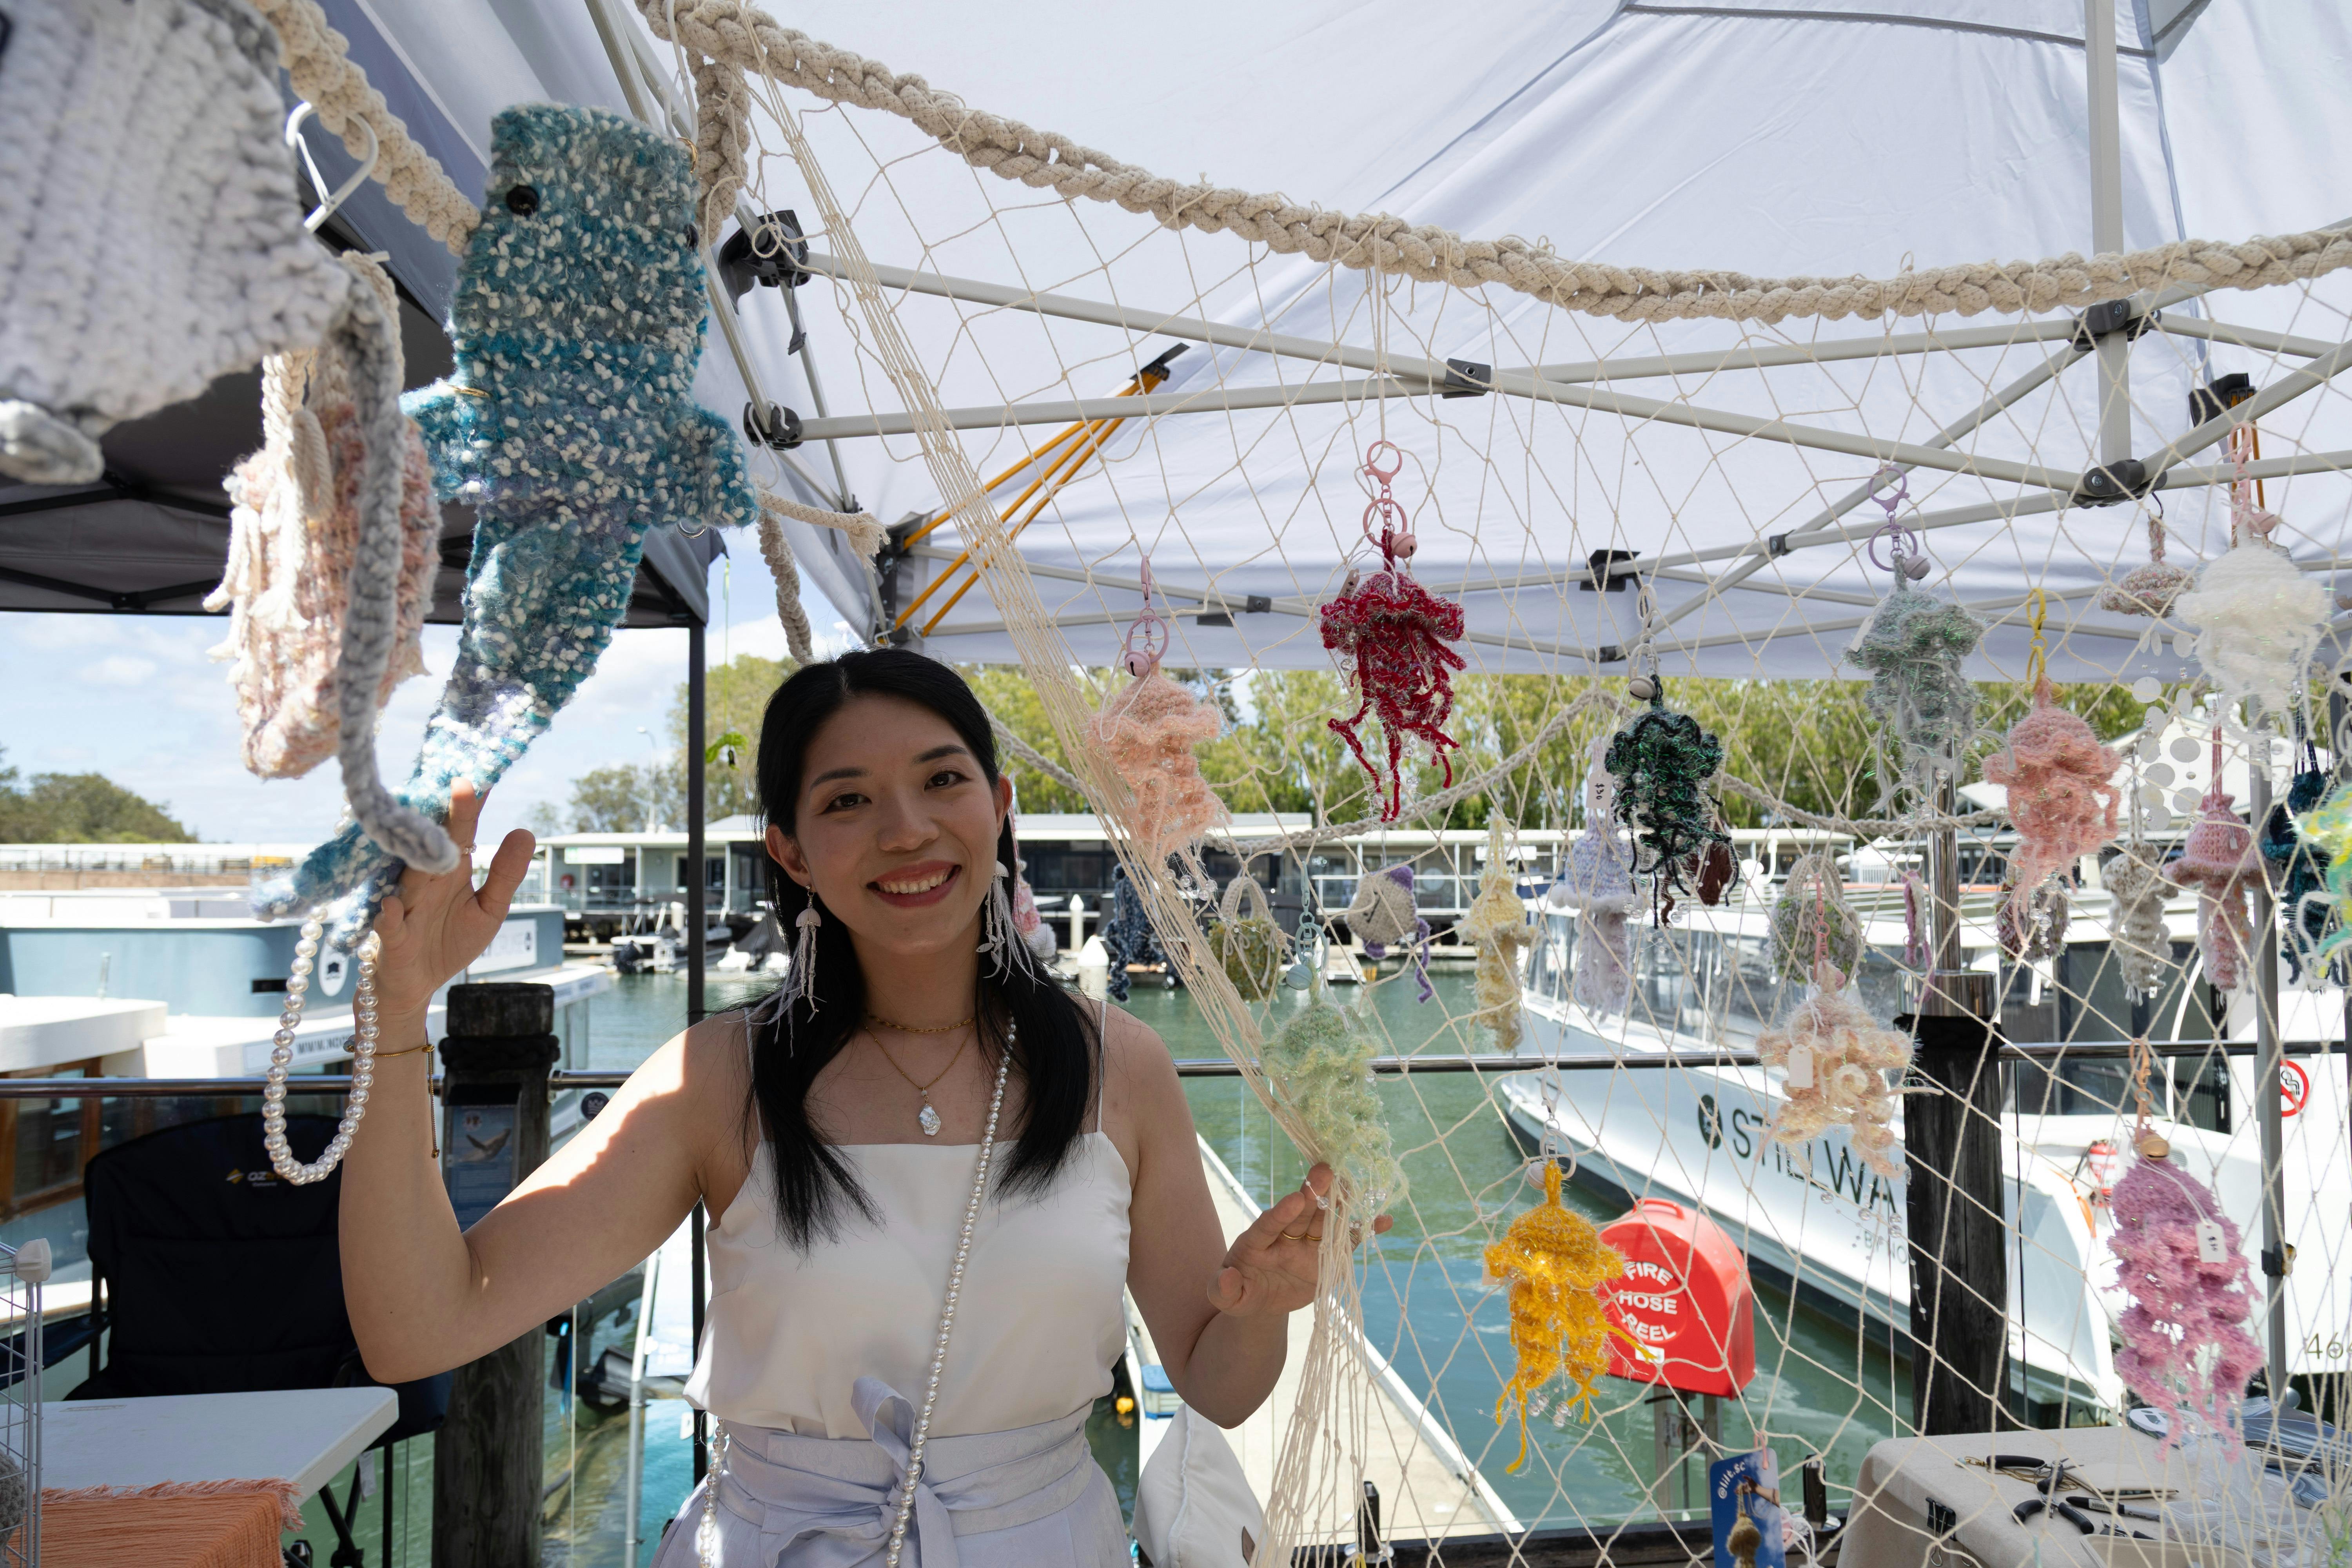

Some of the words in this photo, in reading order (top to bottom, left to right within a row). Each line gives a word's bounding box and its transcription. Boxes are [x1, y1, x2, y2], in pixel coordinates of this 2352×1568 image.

[1594, 783, 1604, 800] $30
[1623, 1261, 1674, 1287] FIRE
[1618, 1289, 1678, 1315] HOSE
[1621, 1313, 1677, 1341] REEL
